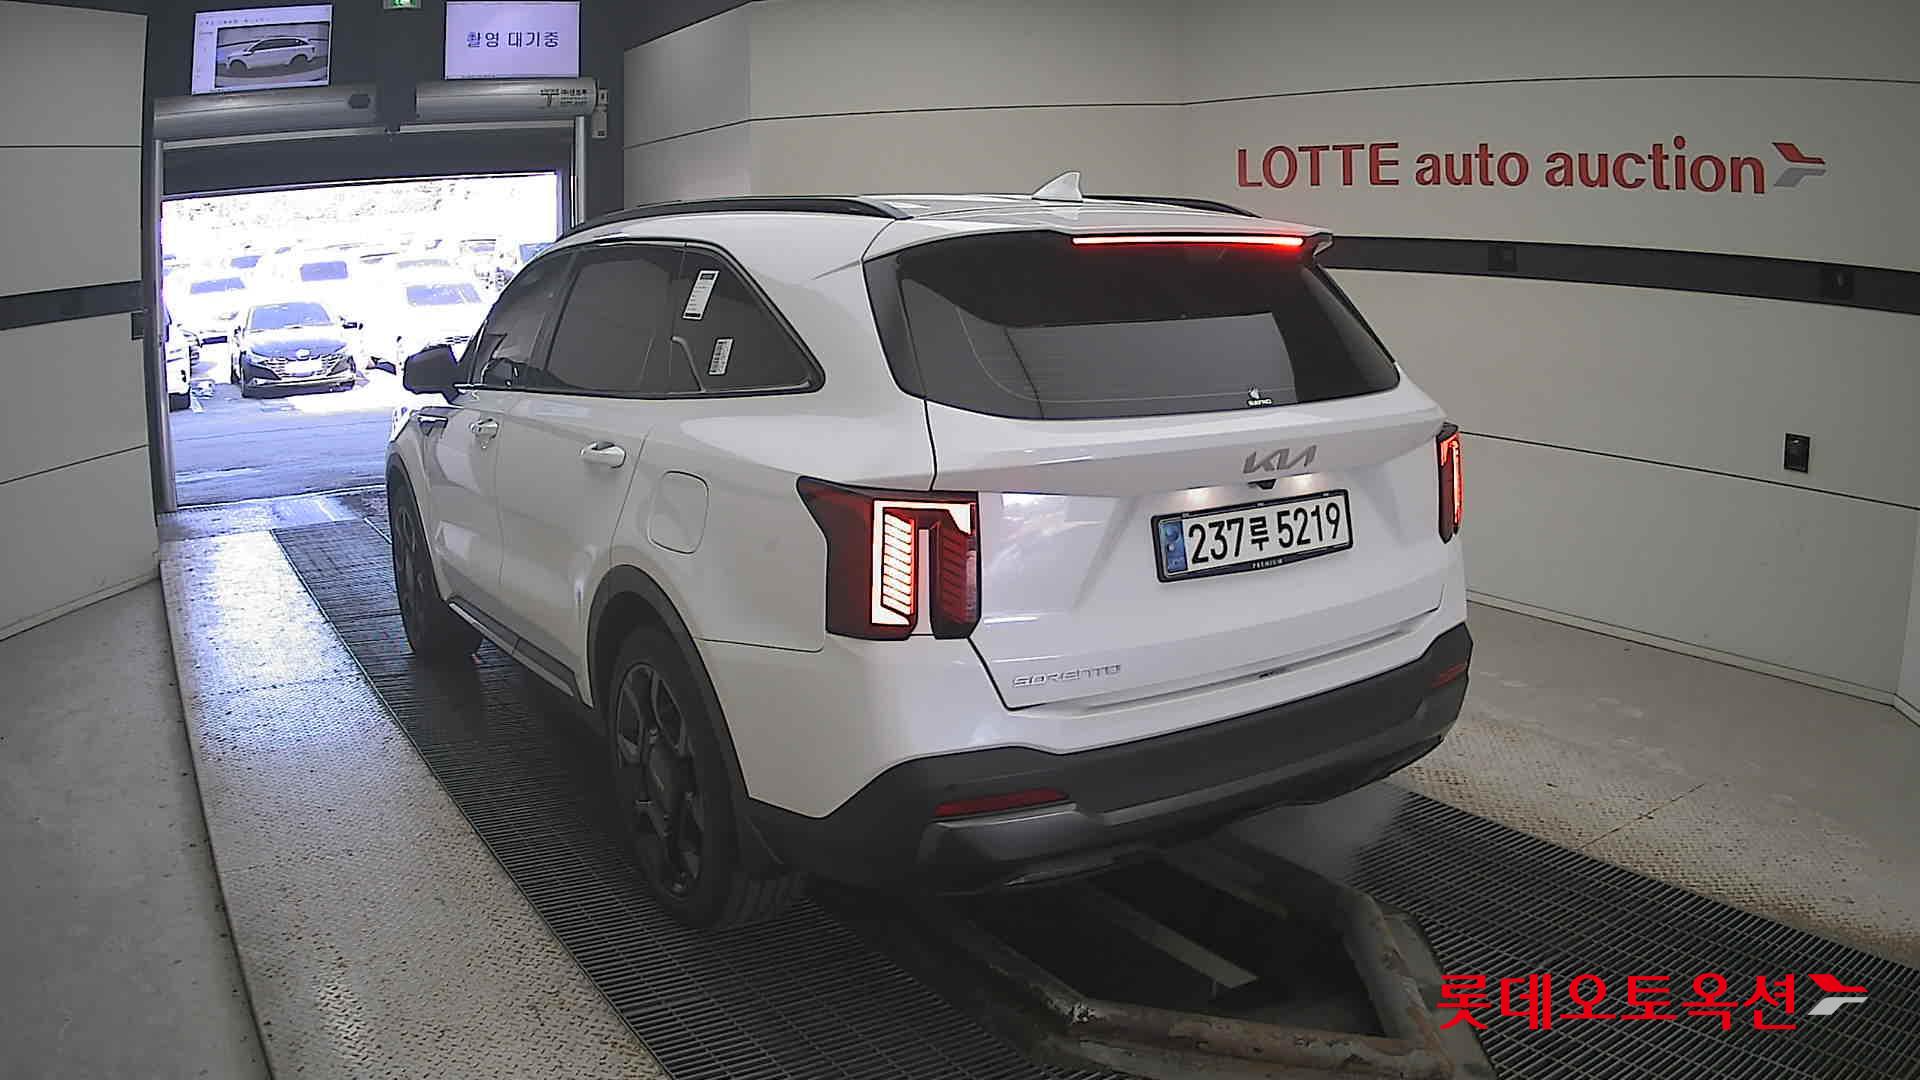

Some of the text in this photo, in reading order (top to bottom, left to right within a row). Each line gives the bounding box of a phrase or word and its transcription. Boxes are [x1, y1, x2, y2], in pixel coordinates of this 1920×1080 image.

[508, 31, 559, 48] 대기중
[1238, 136, 1766, 194] LOTTE auto auction
[1243, 444, 1317, 474] KIA
[1013, 664, 1121, 688] SORENTO
